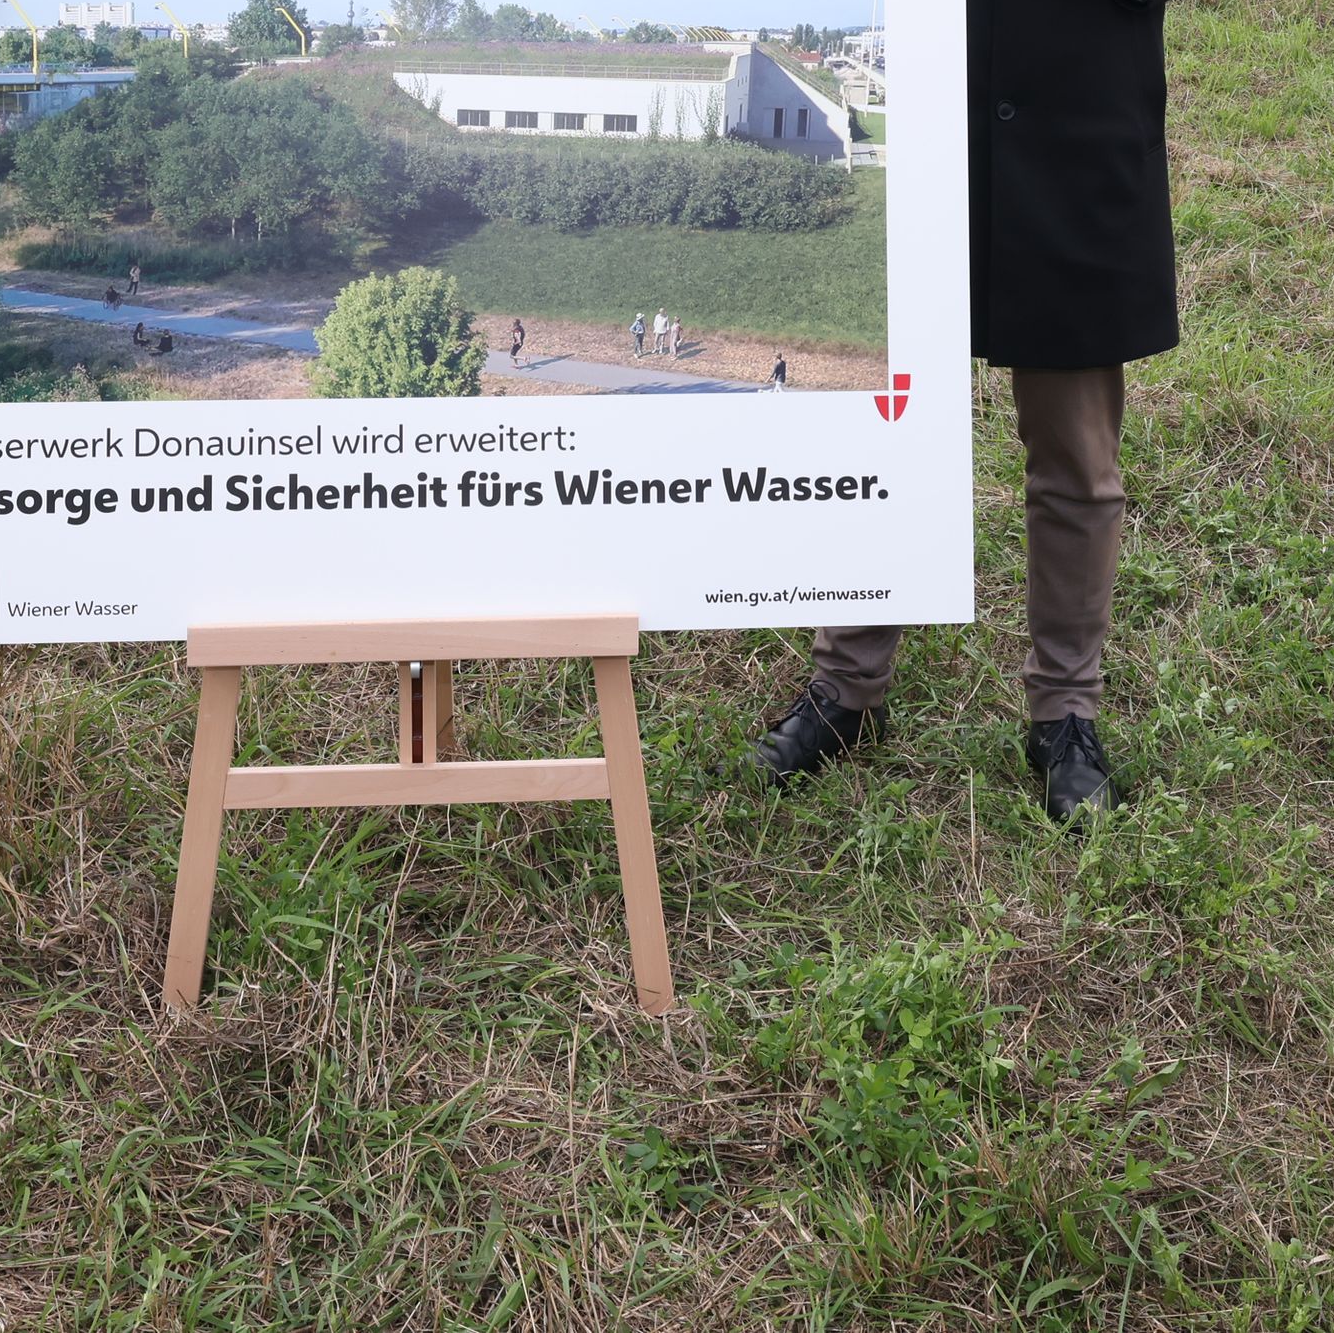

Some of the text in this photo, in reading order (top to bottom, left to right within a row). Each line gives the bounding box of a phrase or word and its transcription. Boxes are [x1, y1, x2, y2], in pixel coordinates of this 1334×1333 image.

[135, 424, 322, 457] Donauinsel
[332, 423, 404, 455] wird
[414, 424, 576, 454] erweitert:
[130, 474, 213, 513] und
[225, 471, 448, 512] Sicherheit
[457, 470, 544, 508] fürs
[554, 468, 712, 506] Wiener
[722, 466, 889, 503] Wasser.
[7, 600, 138, 618] Wiener Wasser
[705, 586, 892, 607] wien.gv.at/wienwasser
